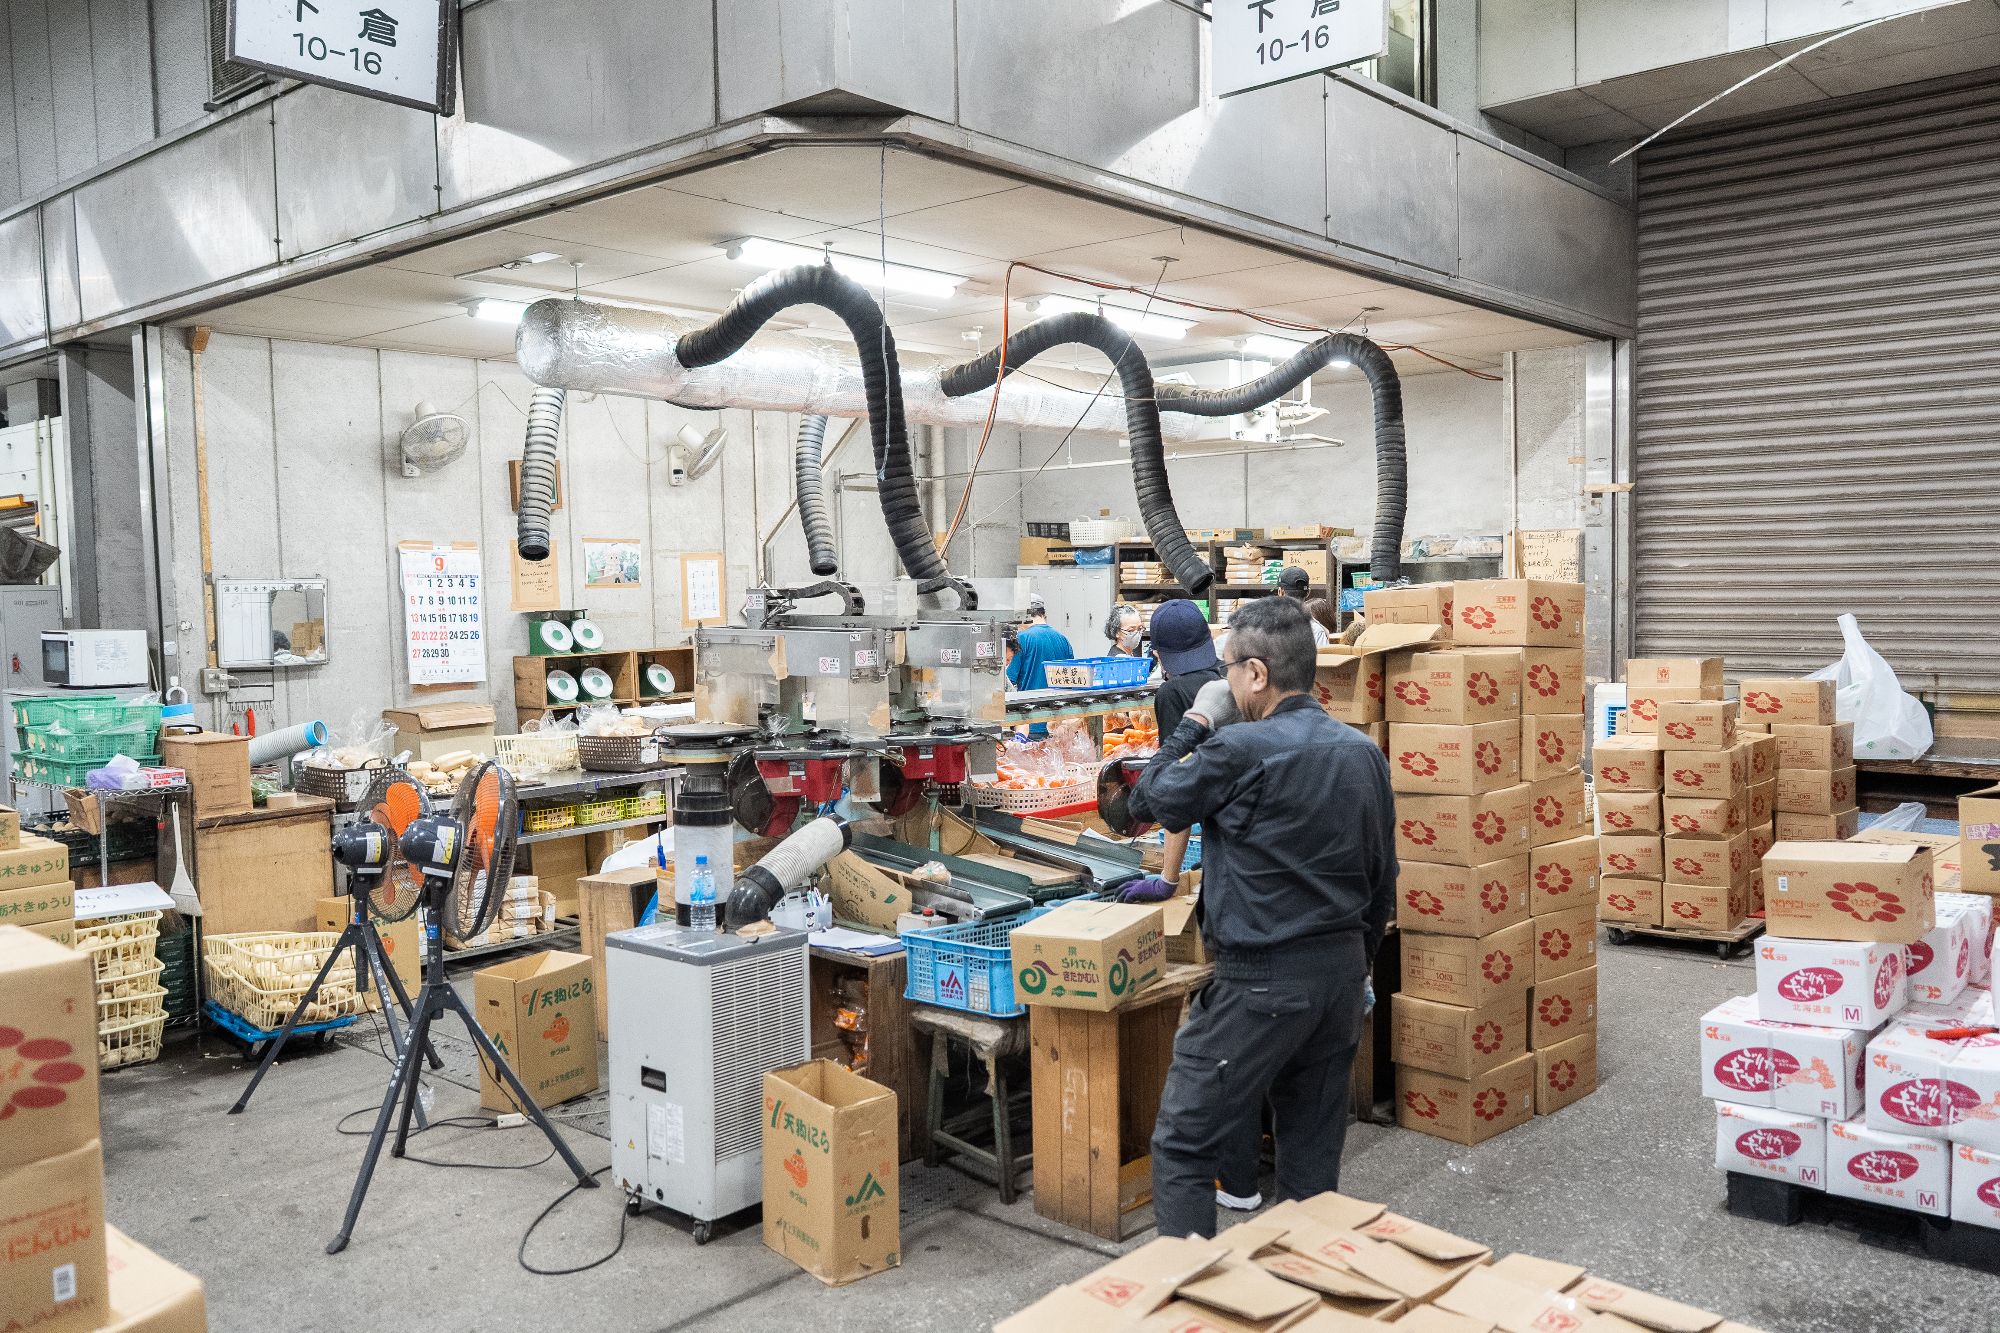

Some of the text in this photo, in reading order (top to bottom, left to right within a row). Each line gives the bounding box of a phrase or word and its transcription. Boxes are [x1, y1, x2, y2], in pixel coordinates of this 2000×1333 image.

[1256, 25, 1330, 64] 10-16
[292, 32, 382, 75] 10-16
[434, 557, 444, 571] 9
[0, 858, 64, 878] 木きゅうり
[1062, 957, 1098, 970] らいでん
[1063, 971, 1100, 984] きたかむい
[541, 978, 592, 1009] 天狗にら
[1844, 1007, 1860, 1022] M
[1820, 1101, 1838, 1114] F1
[1802, 1168, 1816, 1182] M
[1920, 1192, 1936, 1208] M
